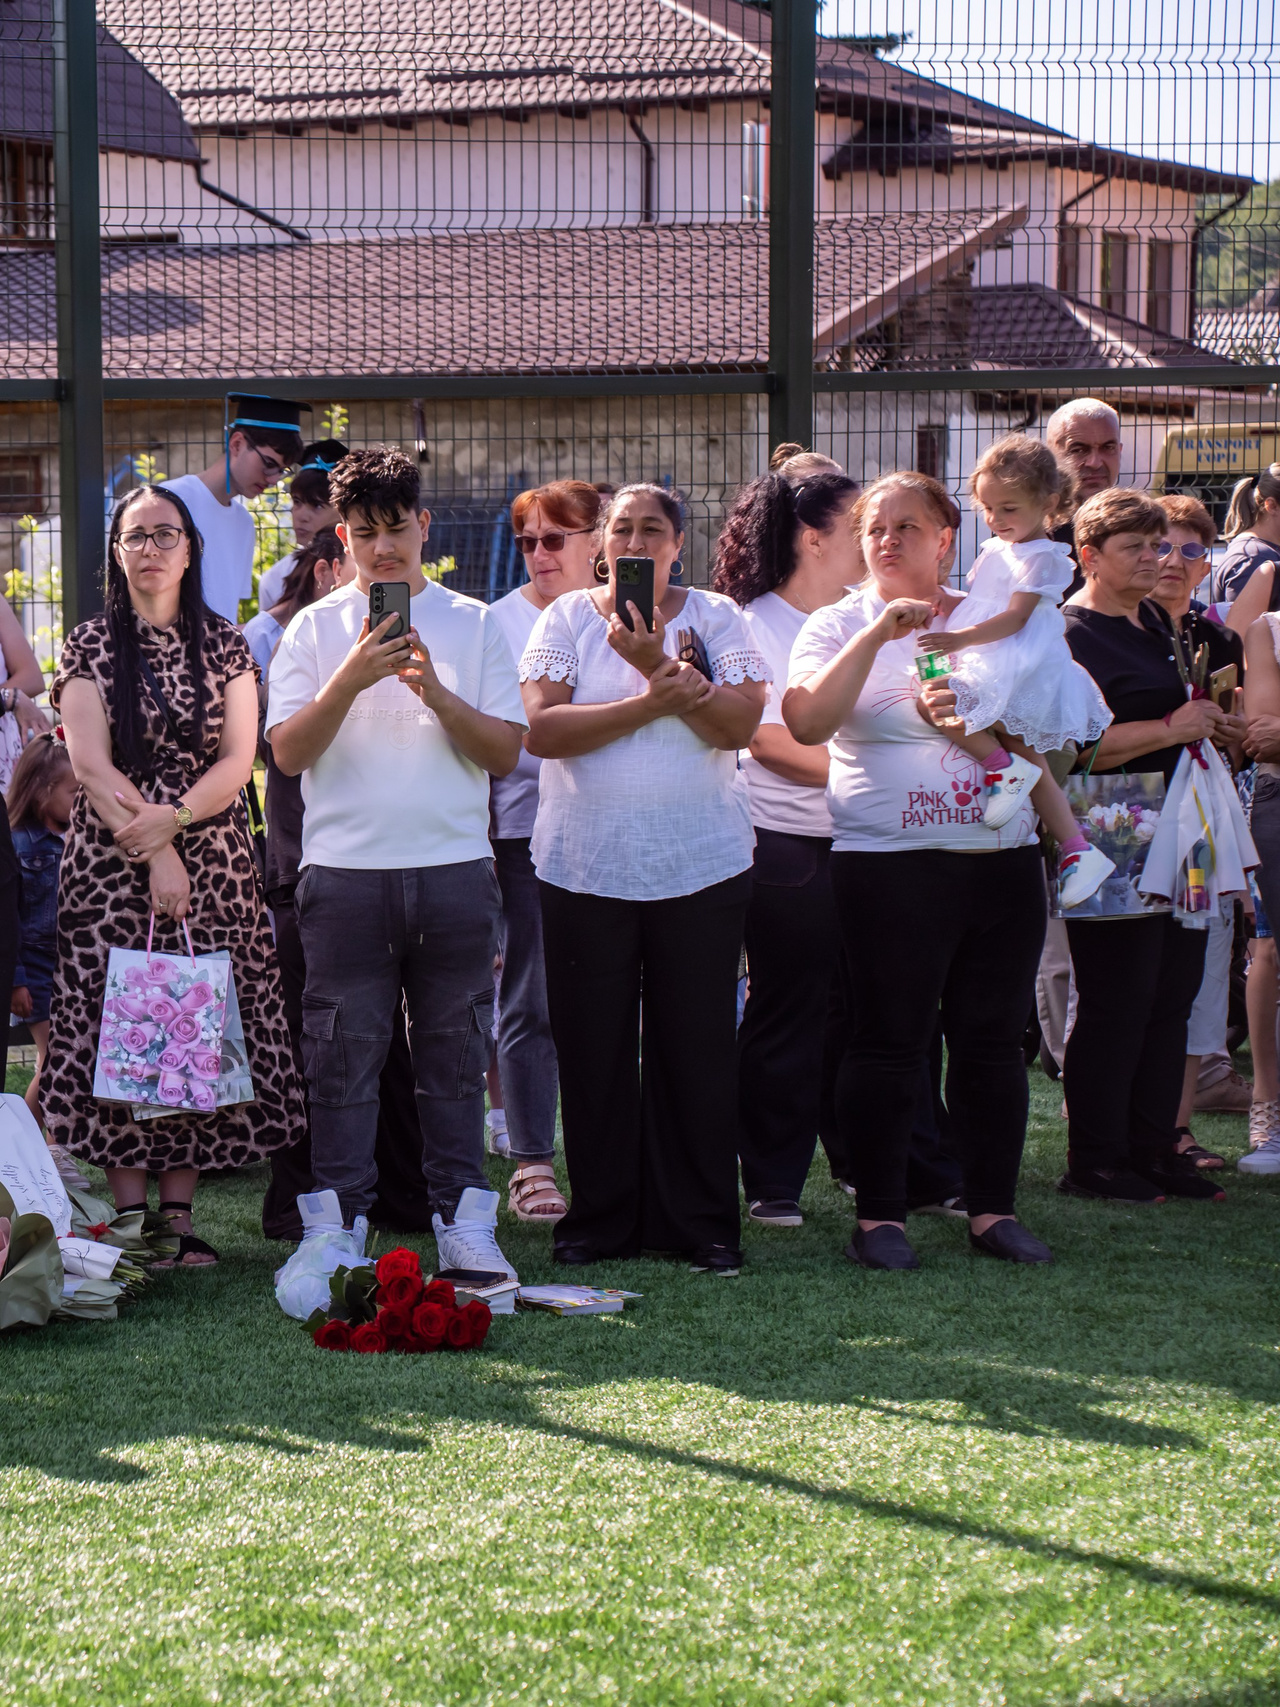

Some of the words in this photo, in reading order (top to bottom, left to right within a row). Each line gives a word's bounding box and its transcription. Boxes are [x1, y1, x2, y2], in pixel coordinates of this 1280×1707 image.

[1177, 439, 1261, 450] TRANSPORT
[908, 790, 949, 809] PINK
[901, 807, 984, 829] PANTHER
